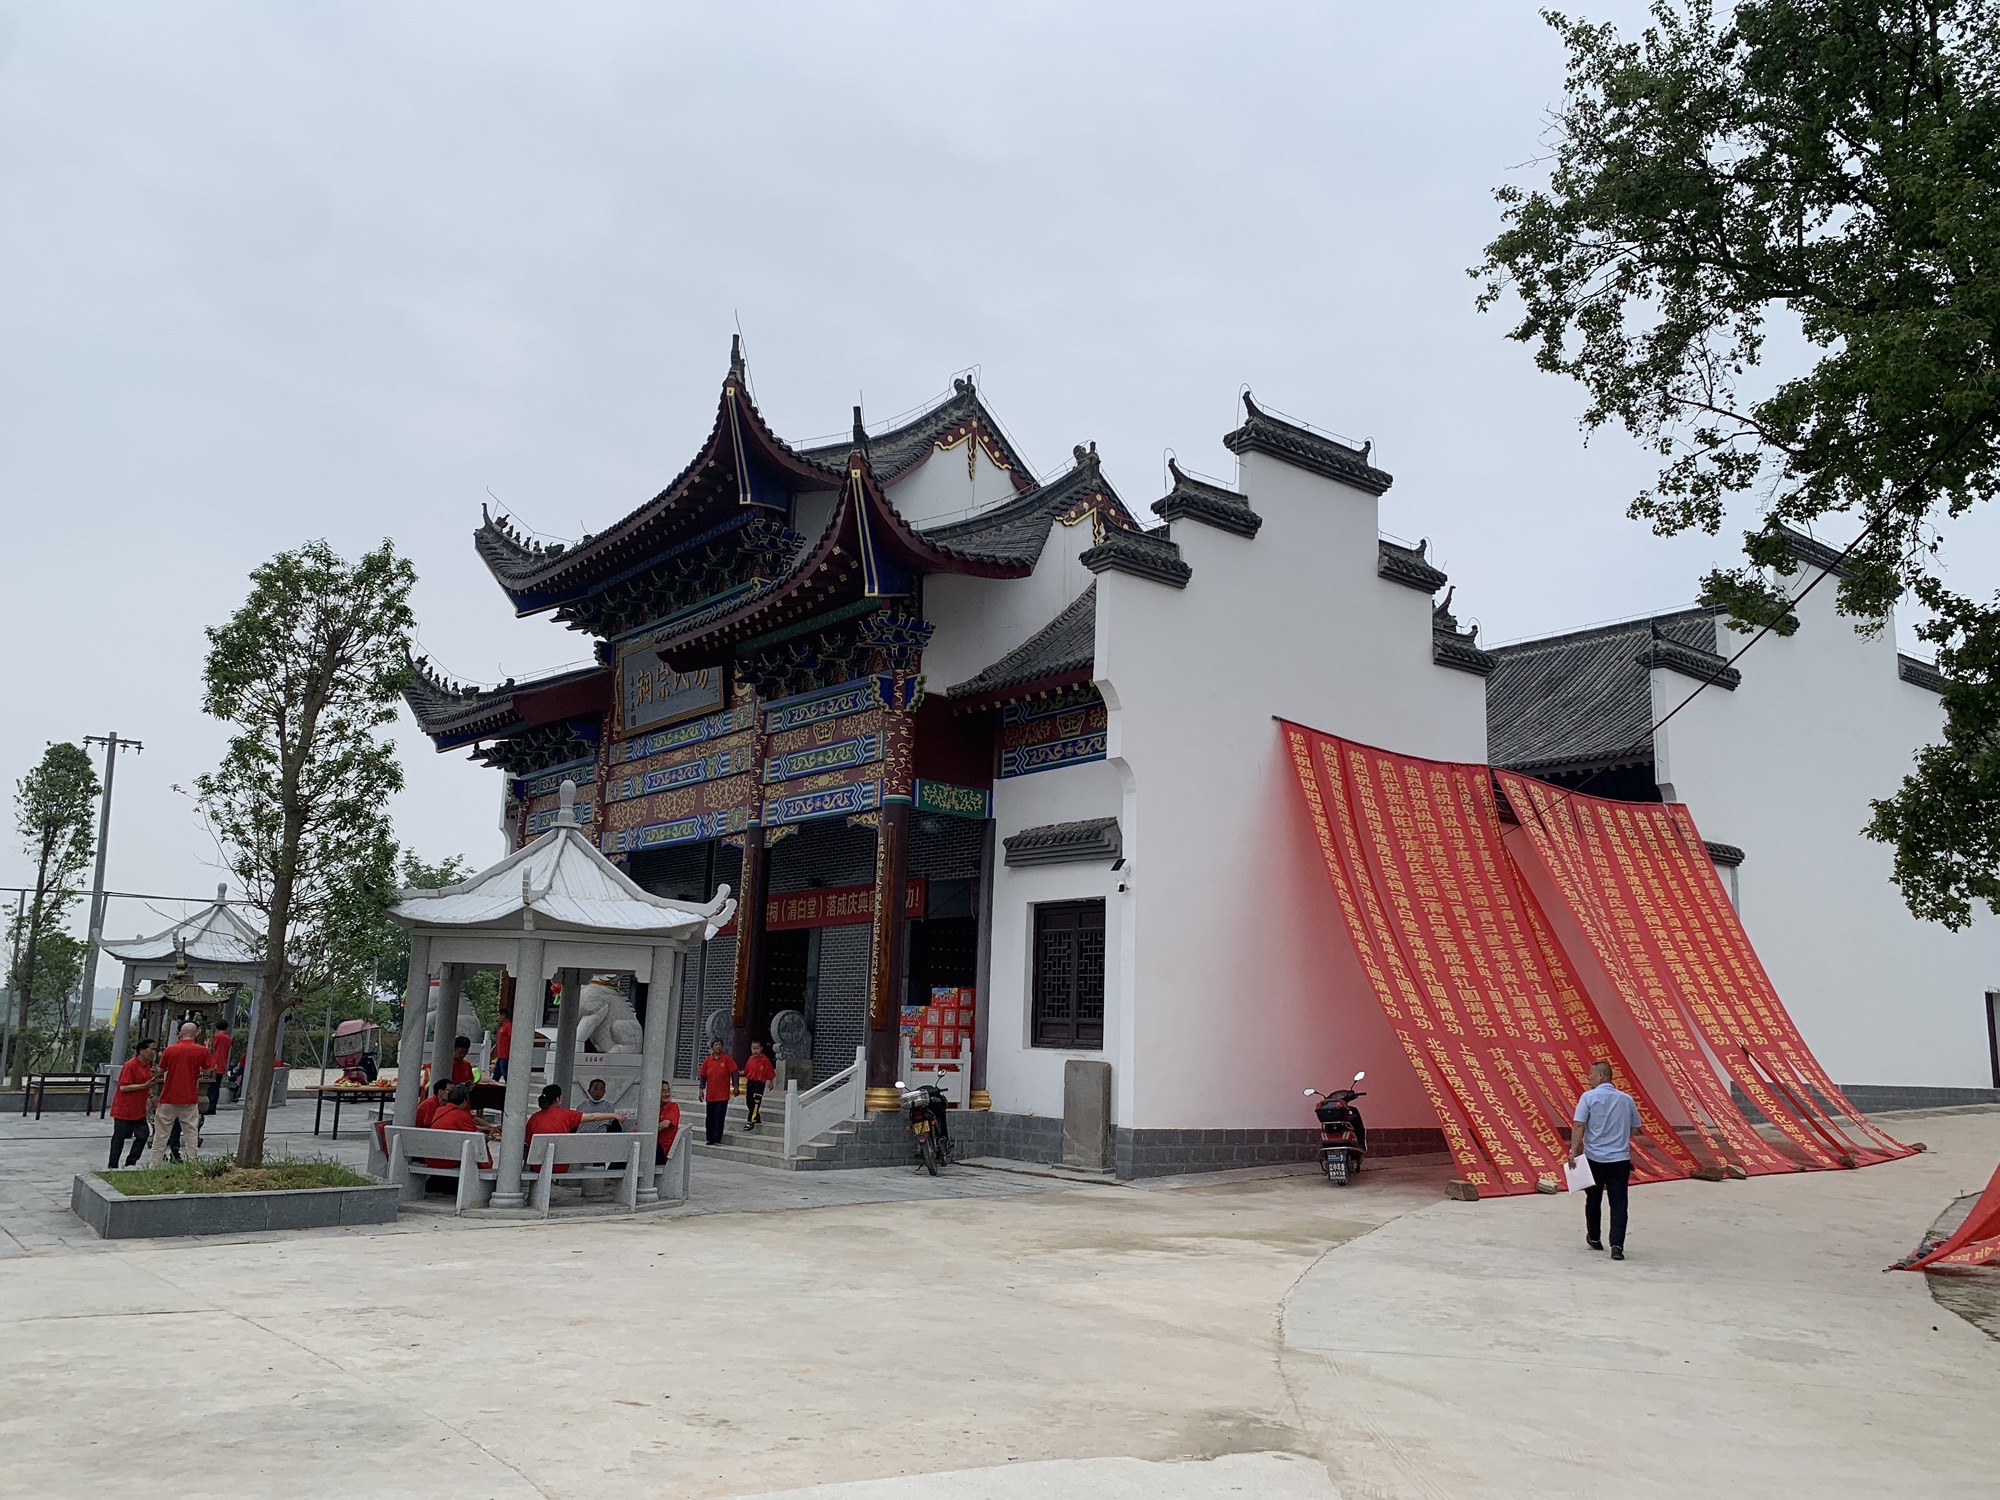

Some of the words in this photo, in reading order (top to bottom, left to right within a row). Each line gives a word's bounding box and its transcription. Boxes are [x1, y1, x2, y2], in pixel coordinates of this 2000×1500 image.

[1425, 1037, 1514, 1166] 北京市房氏文化研究会
[1504, 1171, 1529, 1185] 贺
[1458, 1042, 1546, 1167] 上海市房氏文化研究会
[1466, 1171, 1490, 1185] 贺
